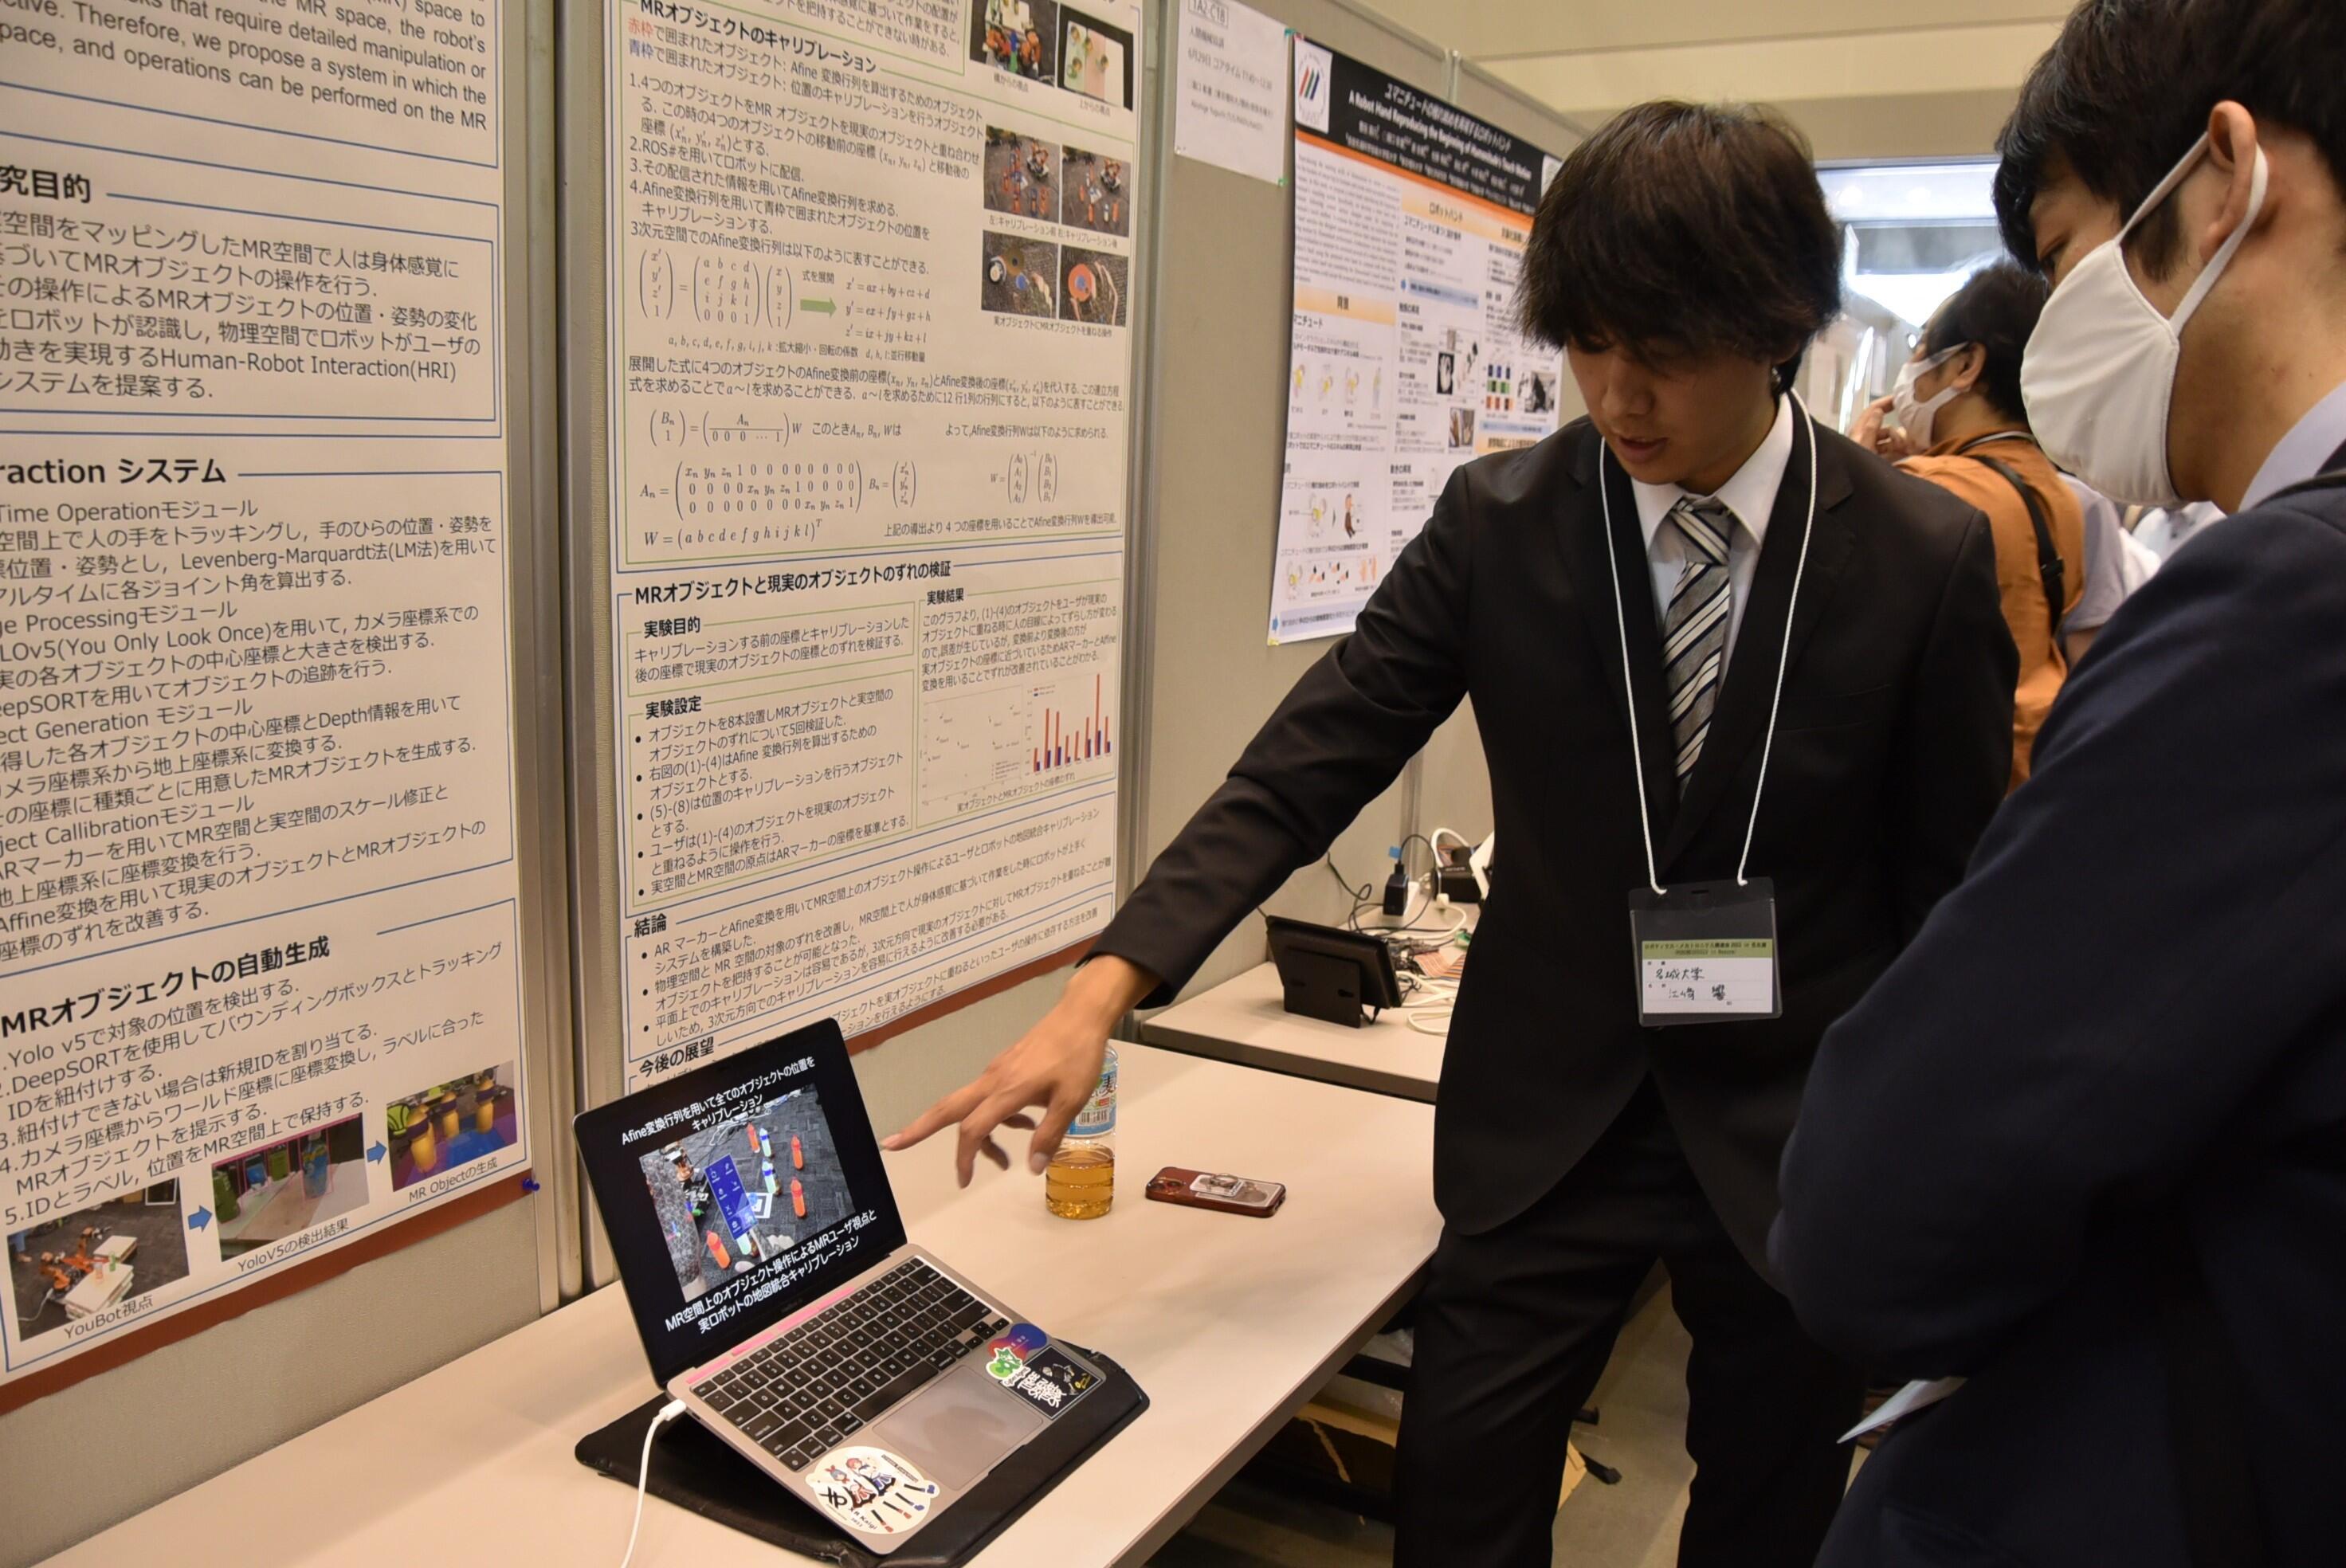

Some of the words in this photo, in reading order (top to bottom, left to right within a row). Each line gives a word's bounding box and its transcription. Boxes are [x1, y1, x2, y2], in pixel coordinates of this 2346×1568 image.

[335, 5, 391, 34] space,
[400, 18, 425, 39] the
[434, 28, 485, 53] robot's
[471, 10, 484, 27] to
[640, 0, 877, 74] MRオブジェクトのキャリブレーション
[73, 1, 186, 46] Therefore,
[192, 30, 222, 51] we
[228, 39, 304, 69] propose
[311, 56, 322, 72] a
[328, 61, 387, 88] system
[393, 70, 407, 90] in
[413, 75, 457, 100] which
[463, 84, 486, 105] the
[215, 7, 282, 36] require
[288, 21, 357, 52] detailed
[363, 40, 466, 76] manipulation
[471, 63, 485, 79] or
[73, 37, 116, 61] and
[124, 48, 232, 84] operations
[239, 70, 273, 92] can
[280, 75, 304, 96] be
[311, 84, 397, 116] performed
[403, 100, 424, 120] on
[430, 104, 454, 124] the
[461, 108, 487, 131] MR
[0, 210, 459, 280] 空間をマッピングしたMR空間で人は身体感覚に
[0, 276, 478, 331] の操作によるMRオブジェクトの位置・姿勢の変化
[118, 458, 226, 484] システム
[635, 560, 951, 605] MRオブジェクトと現実のオブジェクトのずれの検証
[926, 587, 964, 606] 実験結果
[26, 601, 237, 632] Processingモジュール
[644, 616, 701, 639] 実験目的
[114, 633, 159, 653] Only
[167, 628, 211, 648] Look
[35, 712, 149, 741] Generation
[156, 697, 254, 725] モジュール
[645, 696, 702, 720] 実験設定
[634, 913, 668, 939] 結論
[1, 935, 330, 1038] MRオブジェクトの自動生成
[639, 1036, 715, 1078] 今後の展望
[622, 1054, 817, 1147] Afine変換行列を用いて全てのオブジェクトの位置を
[691, 1093, 764, 1133] キャリブレーション
[237, 1217, 350, 1273] YoloV5の検出結果
[664, 1208, 878, 1333] MR空間上のオブジェクト操作によるMRユーザ視点と
[697, 1235, 861, 1335] 実ロボットの地図統合キャリブレーション
[64, 1294, 154, 1341] YouBot視点
